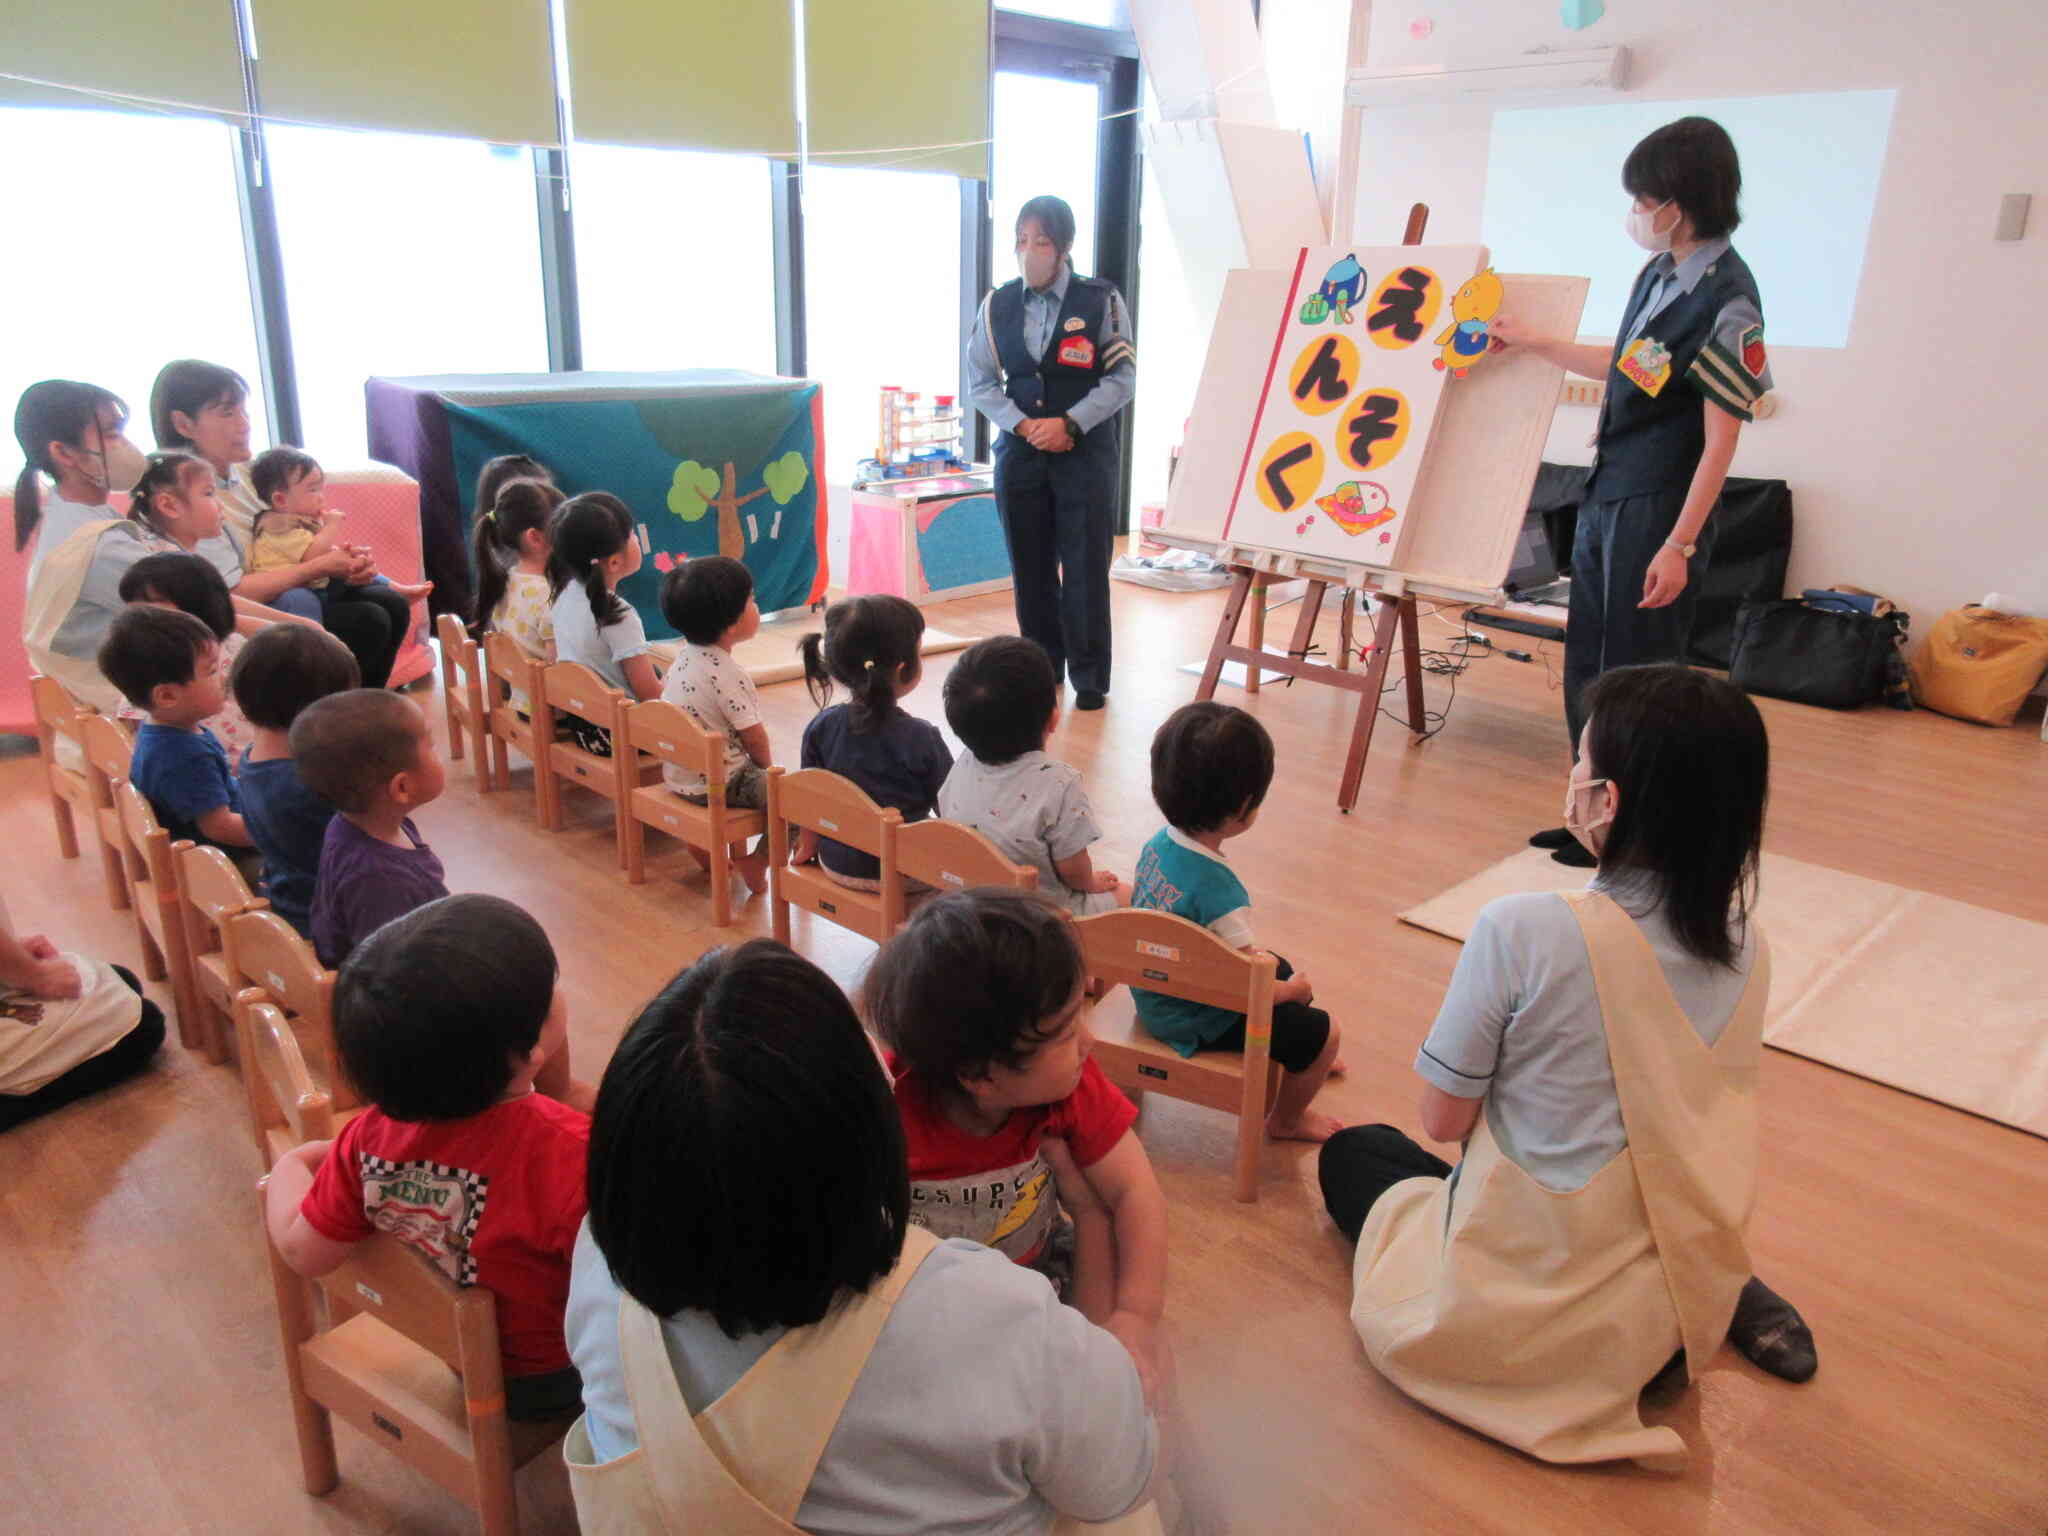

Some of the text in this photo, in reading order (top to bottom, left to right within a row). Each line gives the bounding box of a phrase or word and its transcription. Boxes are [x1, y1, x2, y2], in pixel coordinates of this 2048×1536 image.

[1264, 267, 1431, 511] え ん そ く
[378, 1181, 450, 1207] MENU
